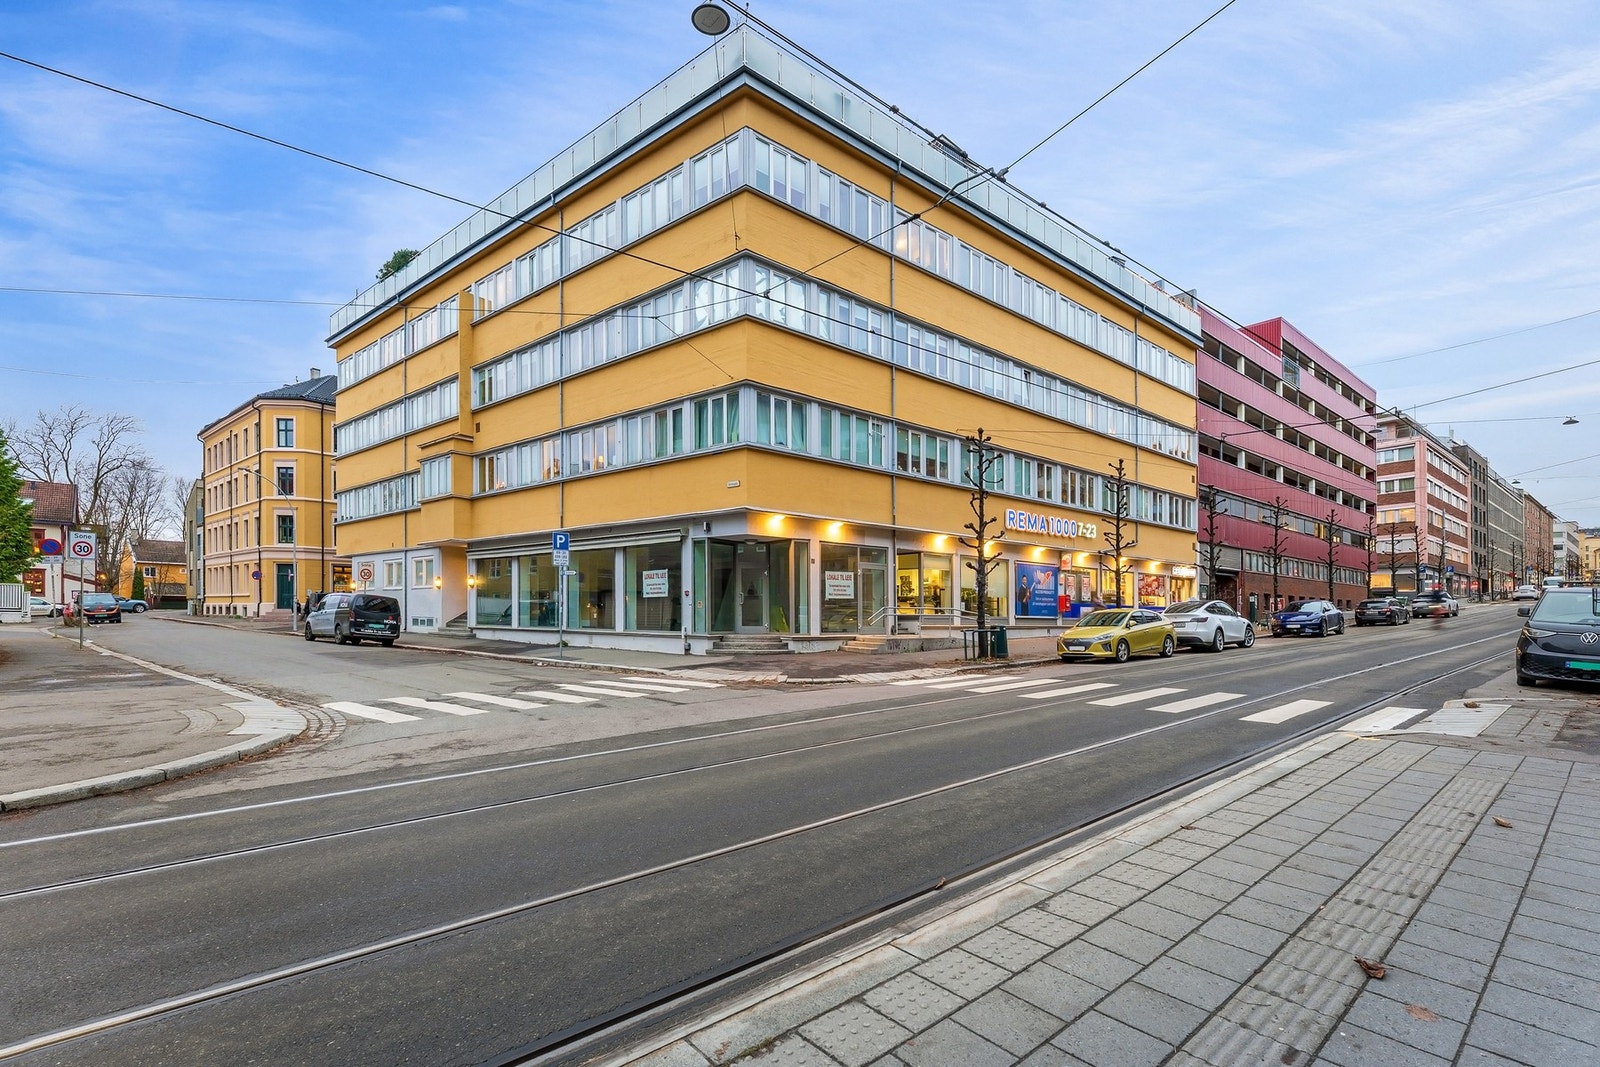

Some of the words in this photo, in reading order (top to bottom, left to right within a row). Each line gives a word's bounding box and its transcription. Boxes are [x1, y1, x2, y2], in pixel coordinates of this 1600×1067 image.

[1005, 509, 1047, 533] REMA
[1048, 516, 1077, 538] 1000
[1077, 522, 1097, 538] 7-23
[556, 534, 566, 548] P
[76, 545, 90, 553] 30
